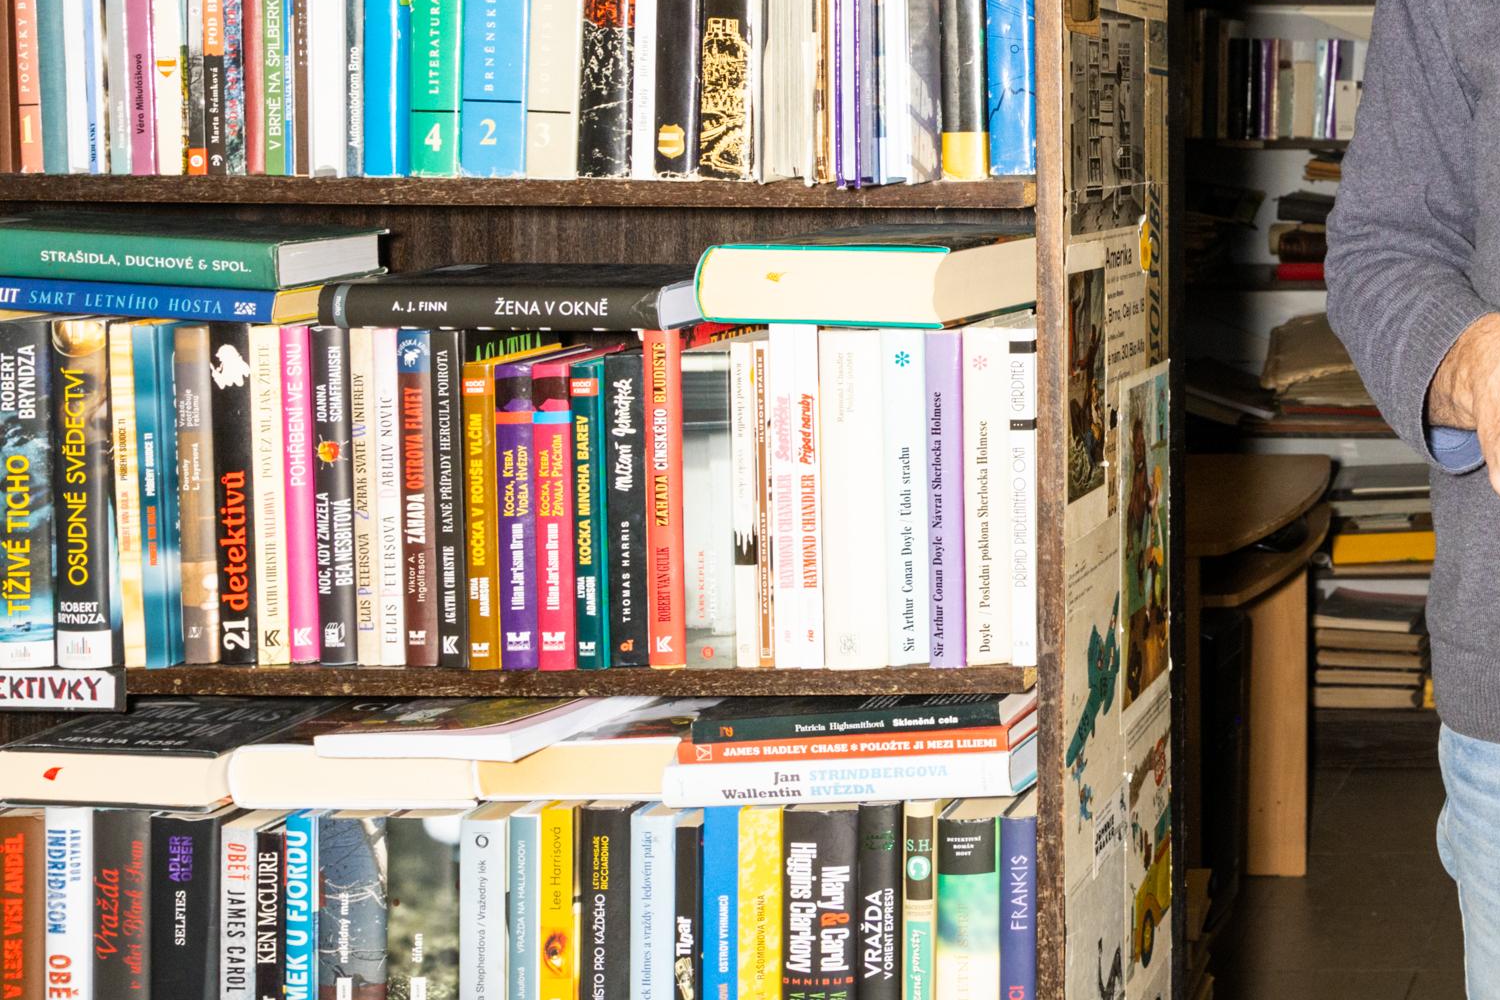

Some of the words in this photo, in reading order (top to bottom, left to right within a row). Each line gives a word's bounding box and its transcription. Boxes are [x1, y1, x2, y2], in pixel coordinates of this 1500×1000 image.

[266, 73, 281, 99] NA
[265, 103, 281, 132] BRNĚ
[479, 119, 497, 145] 2
[268, 137, 279, 149] V
[424, 124, 441, 151] 4
[41, 249, 120, 267] STRAŠIDLA,
[126, 253, 193, 270] DUCHOVÉ
[198, 259, 208, 270] &
[212, 260, 252, 273] SPOL.
[29, 291, 74, 305] SMRT
[86, 291, 158, 310] LETNÍHO
[169, 299, 222, 313] HOSTA
[392, 301, 404, 311] A.
[407, 302, 416, 312] J.
[419, 302, 447, 312] FINN
[494, 297, 541, 317] ŽENA
[545, 301, 555, 316] V
[560, 297, 608, 316] OKNĚ
[290, 344, 302, 375] SNU
[291, 381, 302, 405] VE
[404, 386, 422, 423] FLATEY
[61, 367, 86, 484] SVĚDECTVÍ
[290, 408, 303, 487] POHŘBENÍ
[405, 429, 423, 489] OSTROVA
[7, 455, 31, 532] TICHO
[407, 494, 424, 543] ZÁHADA
[67, 493, 88, 586] OSUDNÉ
[222, 469, 249, 611] detektivů
[8, 538, 32, 617] TÍŽIVÉ
[223, 618, 250, 651] 21
[722, 786, 802, 800] Wallentin
[773, 770, 800, 786] Jan
[258, 851, 278, 927] McCLURE
[821, 865, 850, 908] Mary
[175, 890, 186, 946] SELFIES
[883, 887, 894, 932] EXPRESU
[257, 932, 276, 964] KEN
[860, 889, 882, 979] VRAŽDA
[883, 932, 894, 970] ORIENT
[883, 970, 894, 980] V
